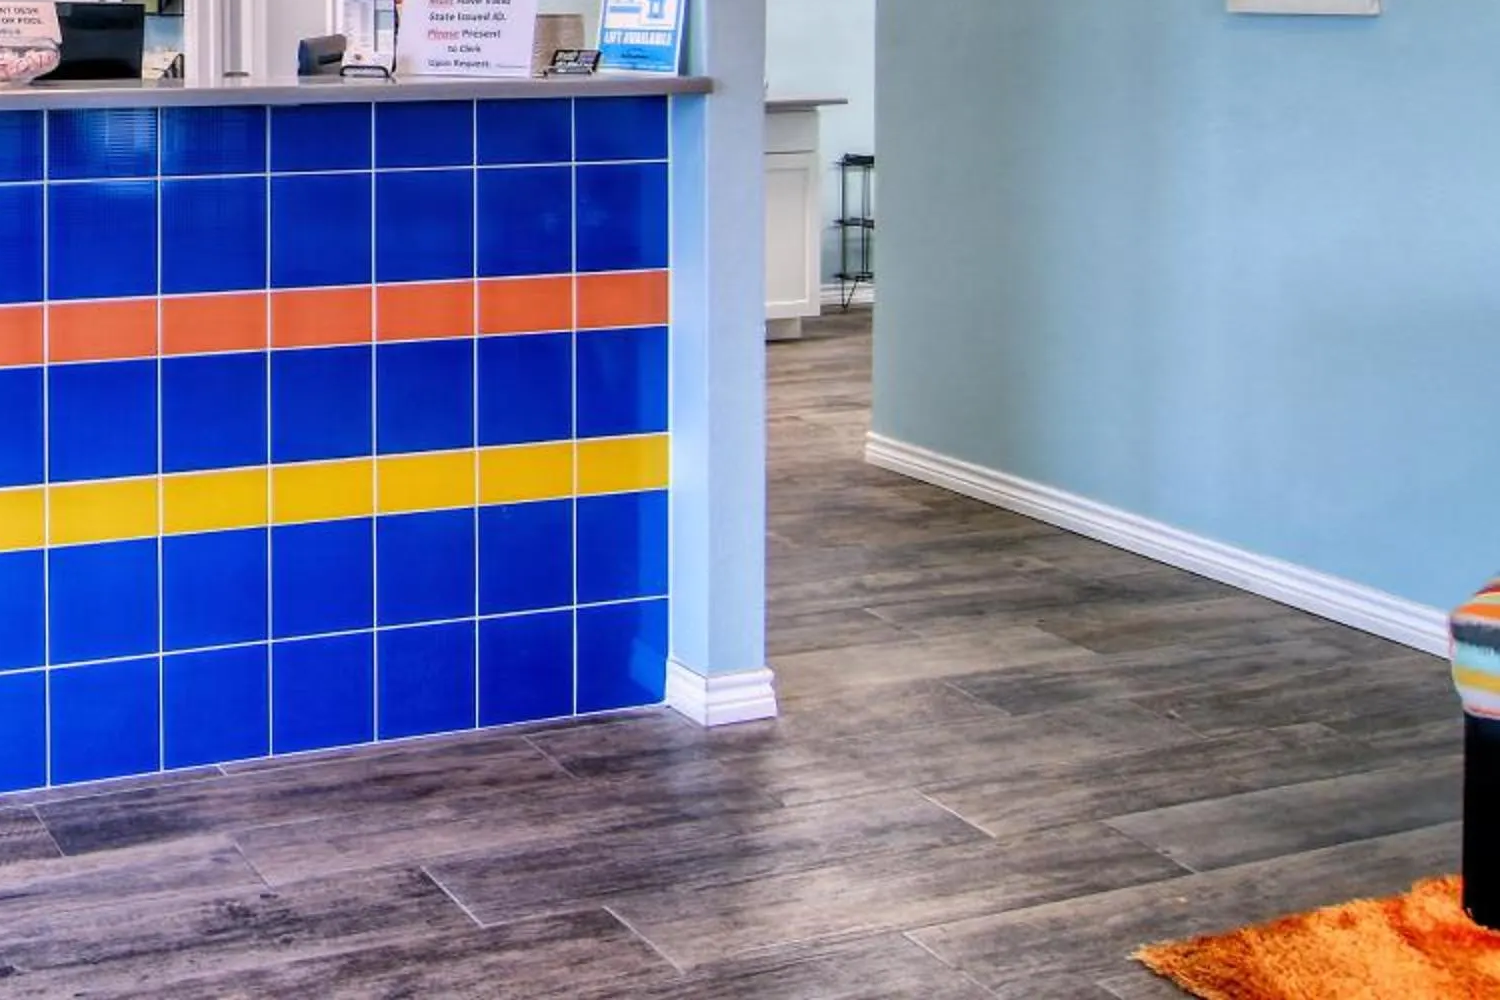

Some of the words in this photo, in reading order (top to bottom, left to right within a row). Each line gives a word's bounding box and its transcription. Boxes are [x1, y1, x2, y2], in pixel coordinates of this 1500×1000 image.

[429, 12, 455, 21] State
[457, 12, 490, 21] Issued
[427, 30, 459, 39] Please
[461, 30, 501, 39] Present
